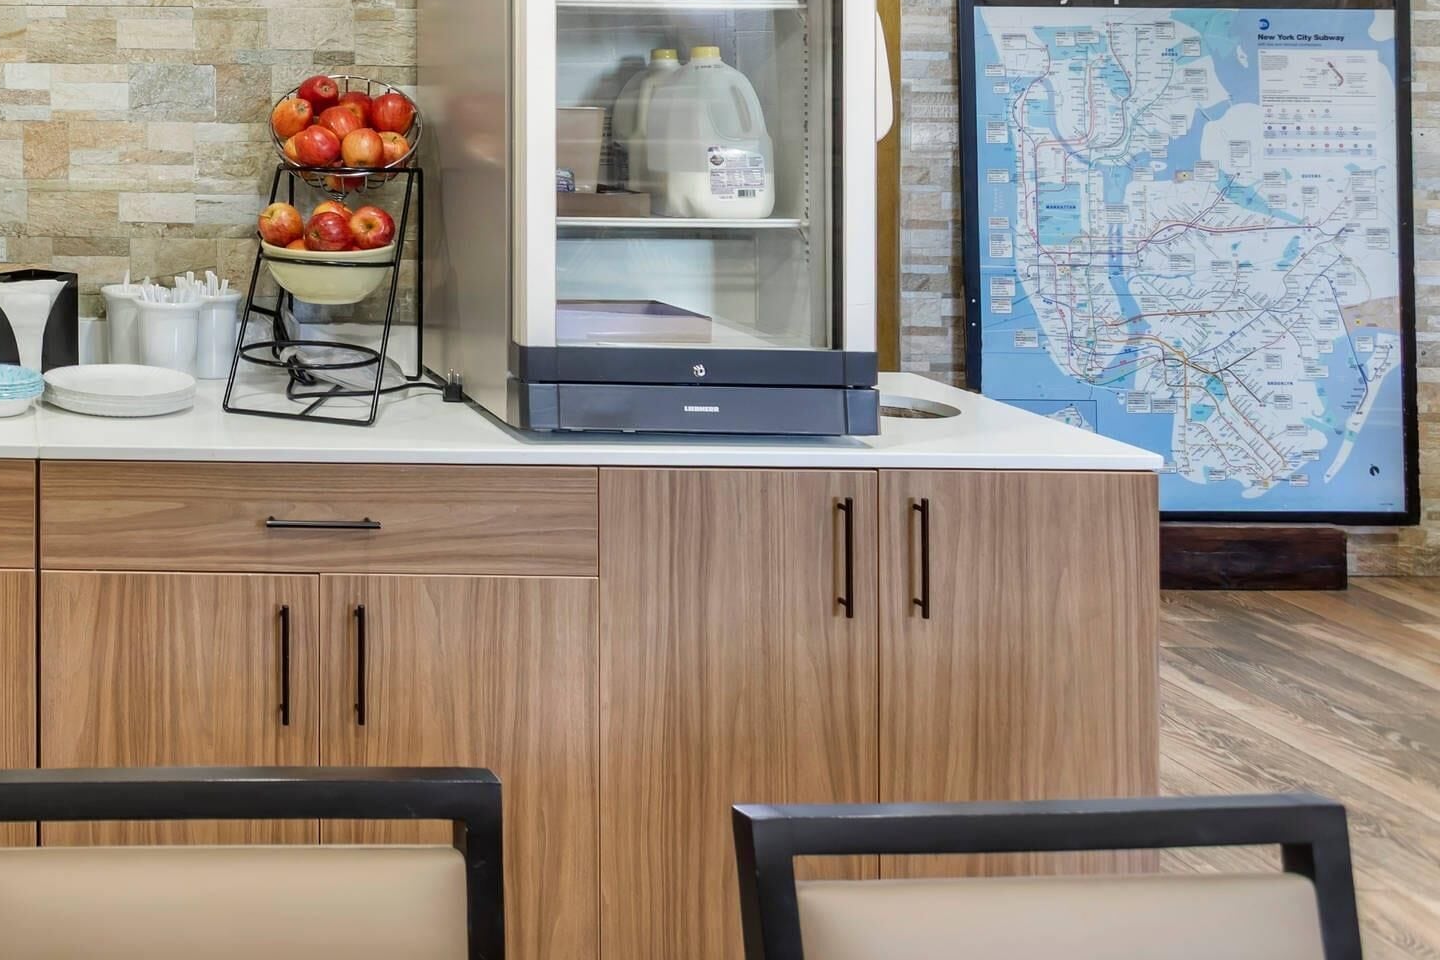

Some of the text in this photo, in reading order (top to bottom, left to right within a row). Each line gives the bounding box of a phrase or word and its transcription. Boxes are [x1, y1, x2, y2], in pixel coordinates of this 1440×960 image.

[1257, 33, 1345, 43] New York City Subway
